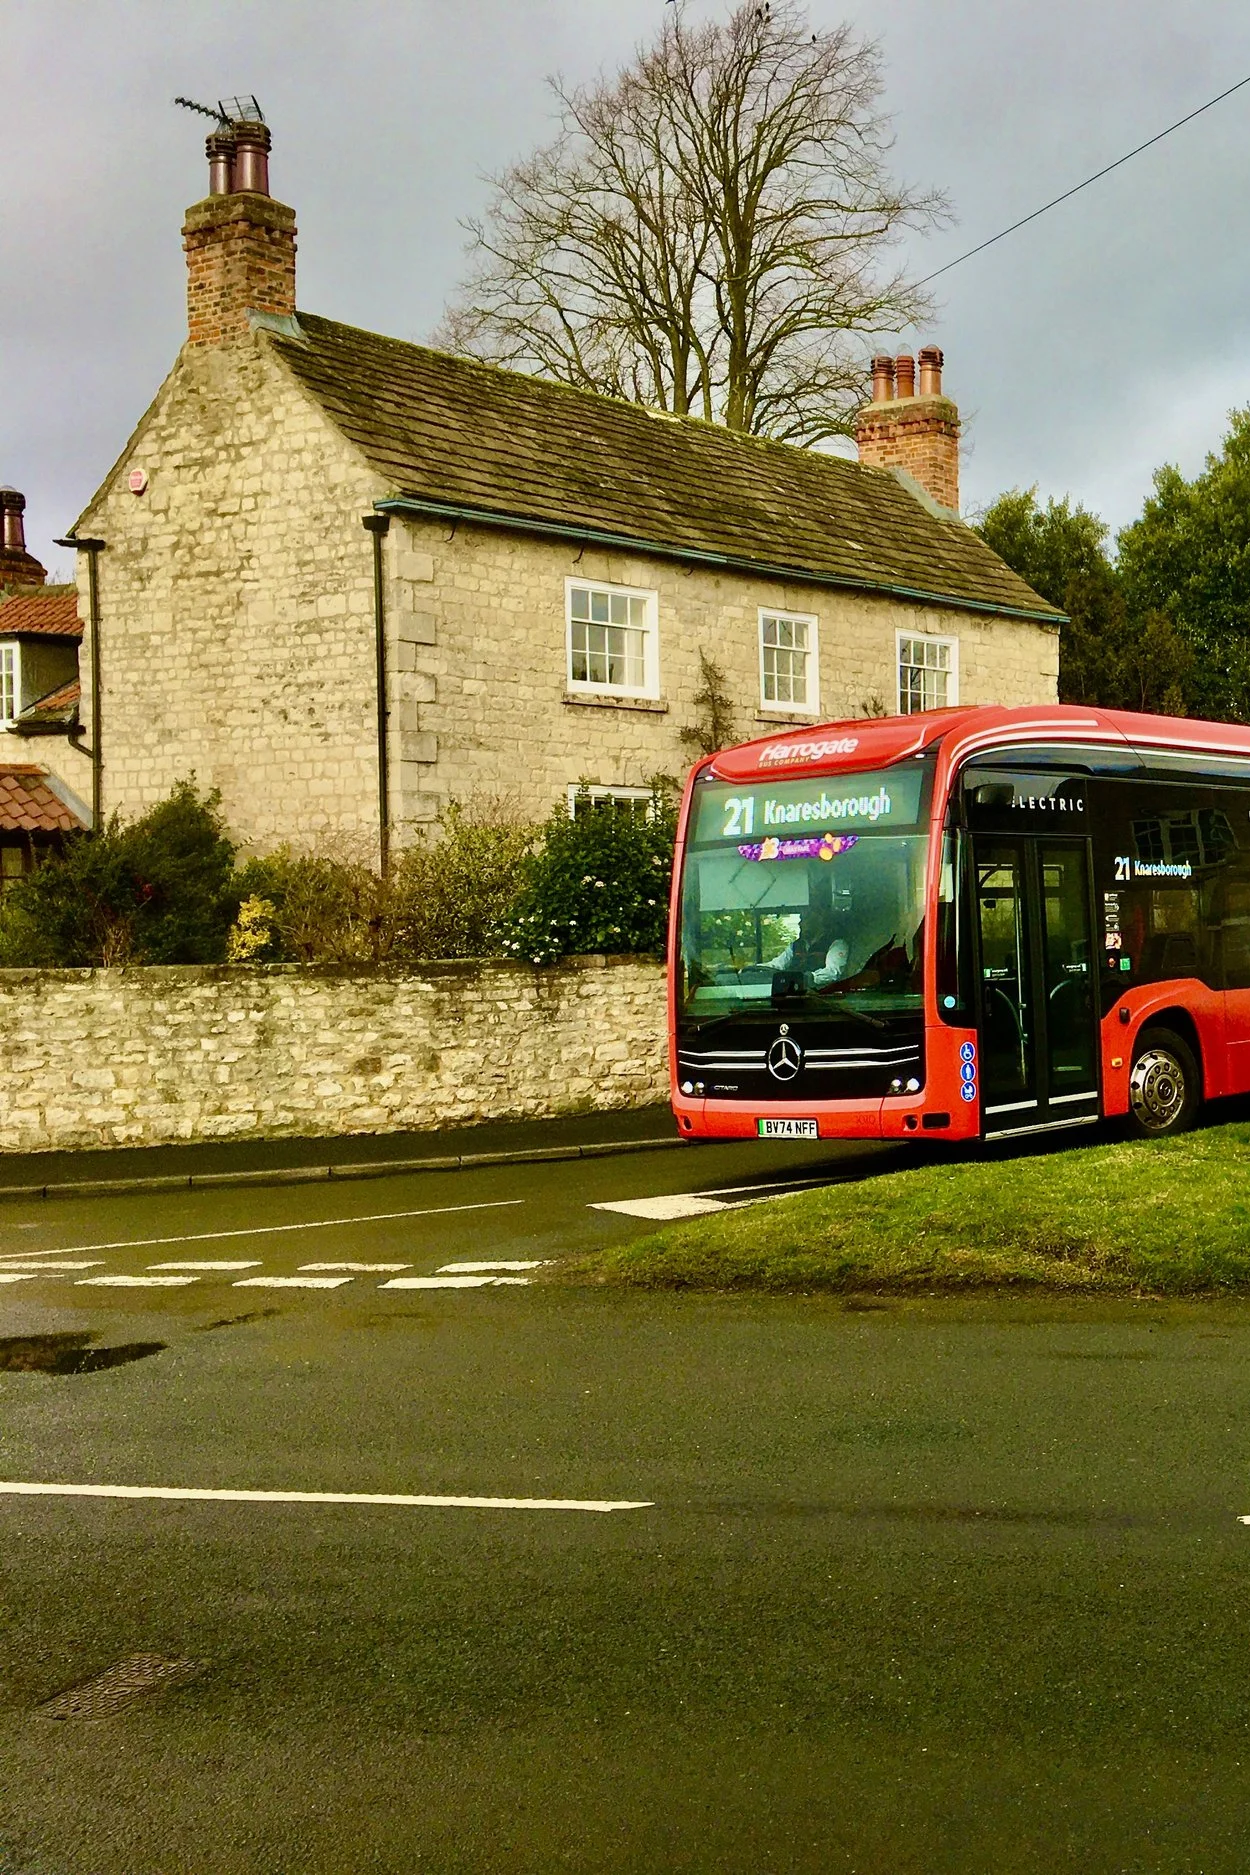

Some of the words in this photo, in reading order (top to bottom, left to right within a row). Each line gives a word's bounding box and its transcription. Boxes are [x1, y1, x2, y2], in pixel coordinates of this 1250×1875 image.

[759, 737, 859, 761] Harrogate
[759, 760, 772, 768] BUS
[774, 757, 811, 766] COMPANY
[723, 797, 755, 836] 21
[764, 787, 891, 825] Knaresborough
[1114, 856, 1131, 881] 21
[1134, 860, 1192, 880] Knaresborough
[766, 1121, 792, 1135] BV74
[795, 1122, 816, 1135] NFF
